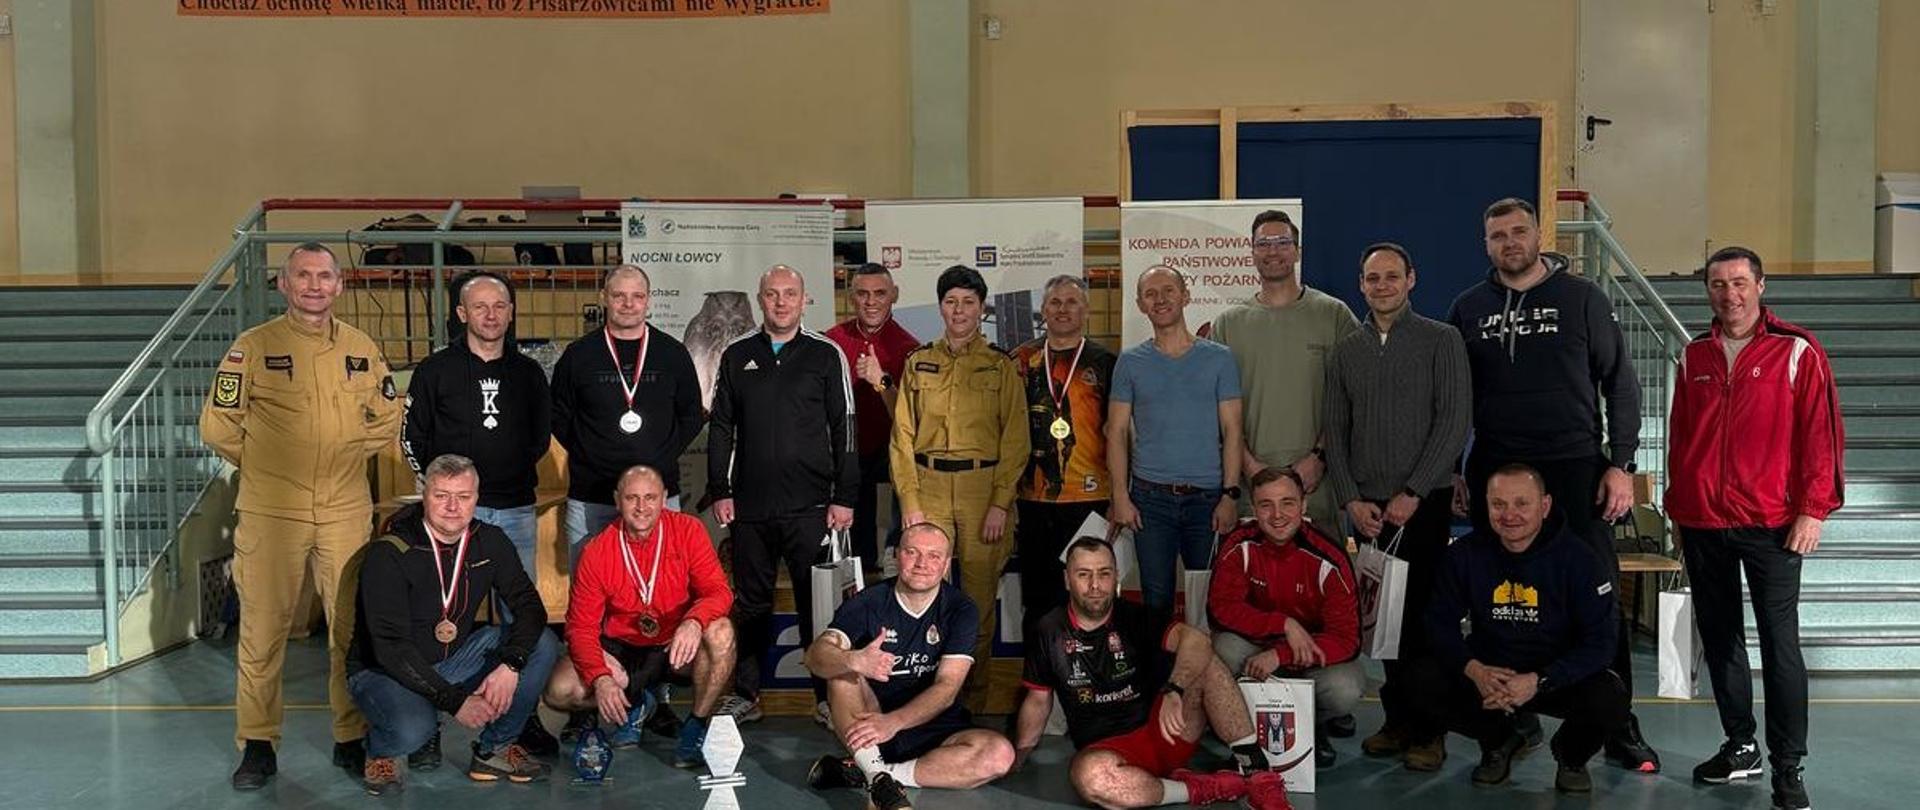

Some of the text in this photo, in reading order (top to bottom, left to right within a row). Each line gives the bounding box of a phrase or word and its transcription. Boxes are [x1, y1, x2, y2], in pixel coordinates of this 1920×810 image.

[1128, 236, 1253, 250] KOMENDA POWIA
[630, 252, 722, 263] NOCNI ŁOWCY
[1163, 254, 1254, 267] PAŃSTWOWE
[1203, 273, 1261, 286] POŻARN
[651, 288, 680, 297] chacz
[482, 391, 500, 414] K
[1083, 476, 1098, 492] 5
